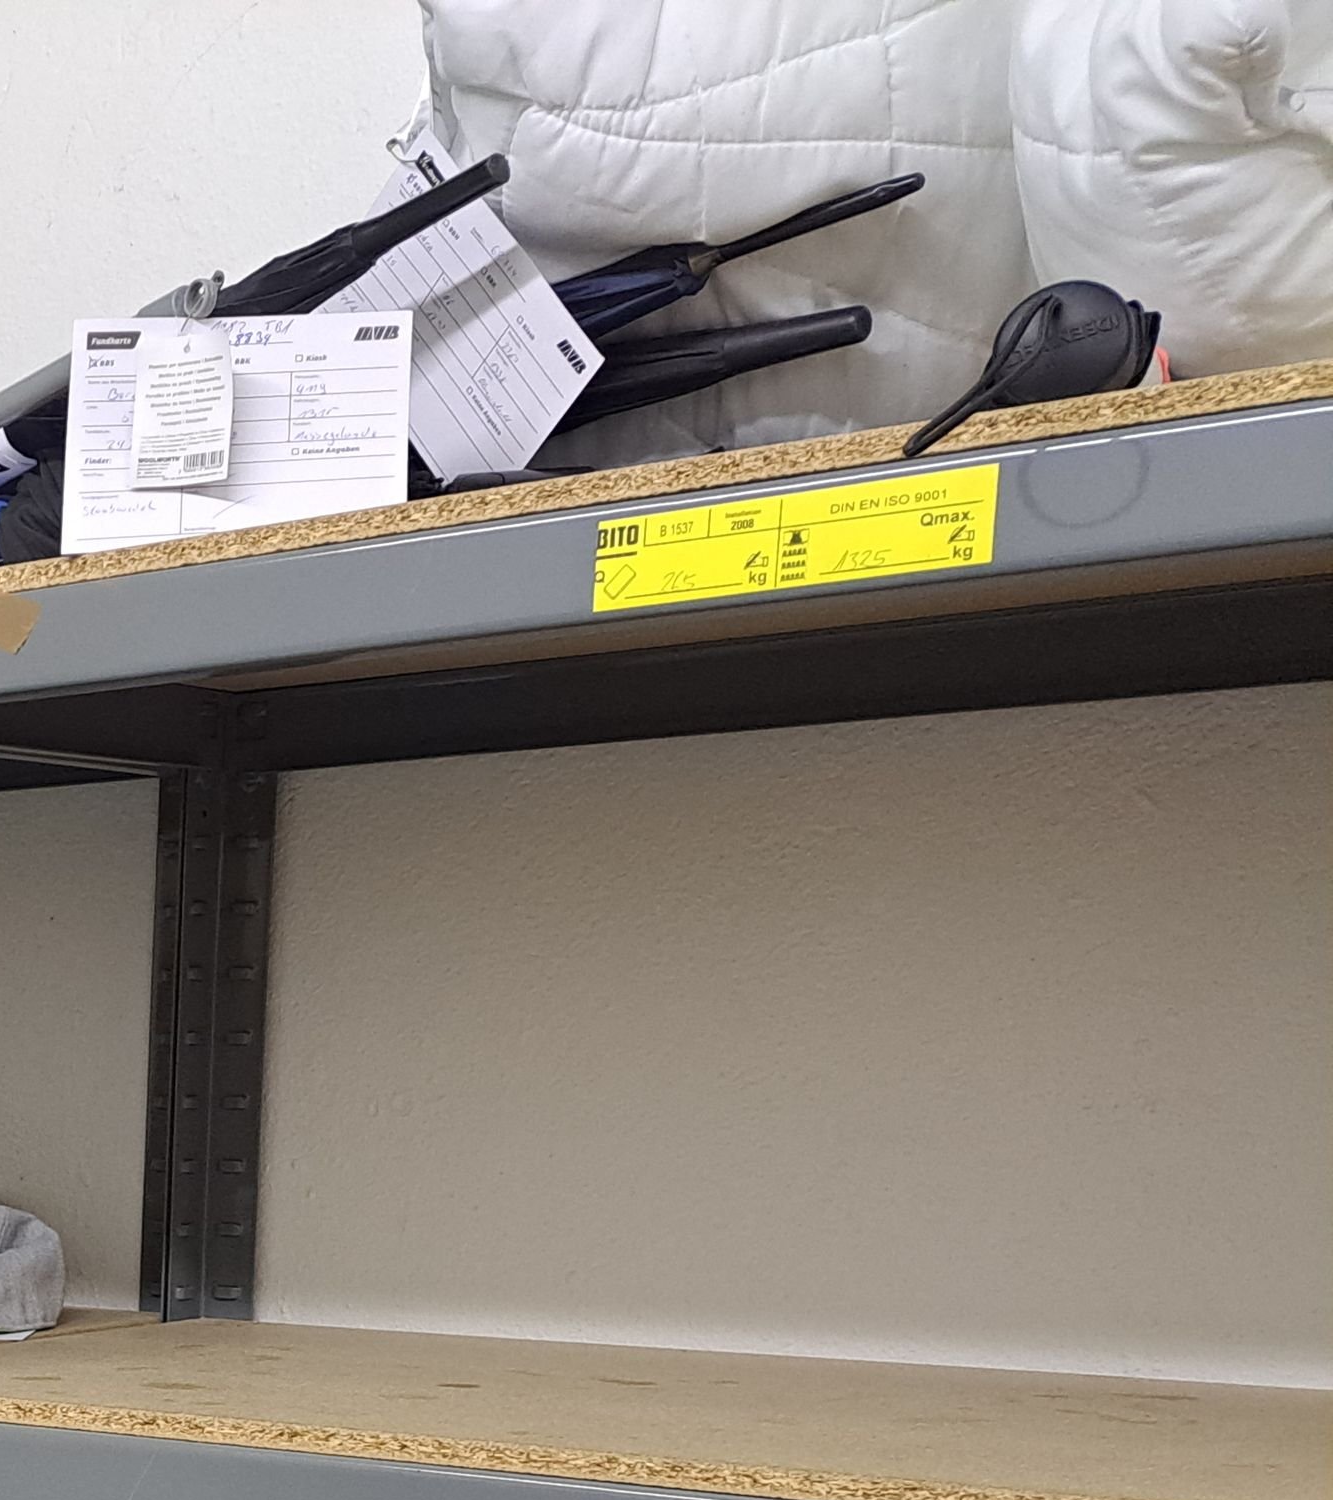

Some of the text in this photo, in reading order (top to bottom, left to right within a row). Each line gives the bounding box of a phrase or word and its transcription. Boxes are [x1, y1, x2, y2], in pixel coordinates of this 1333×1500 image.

[91, 336, 132, 346] Fundkarte
[353, 325, 400, 342] MVB
[306, 354, 327, 362] Kiosk
[326, 446, 360, 456] Angaben
[830, 489, 947, 515] DIN EN ISO 9001
[730, 518, 754, 532] 2008
[920, 511, 975, 528] Qmax.
[597, 524, 639, 550] BITO
[660, 521, 694, 537] B 1537
[834, 549, 892, 571] 1325
[952, 545, 974, 561] kg
[748, 571, 767, 586] kg
